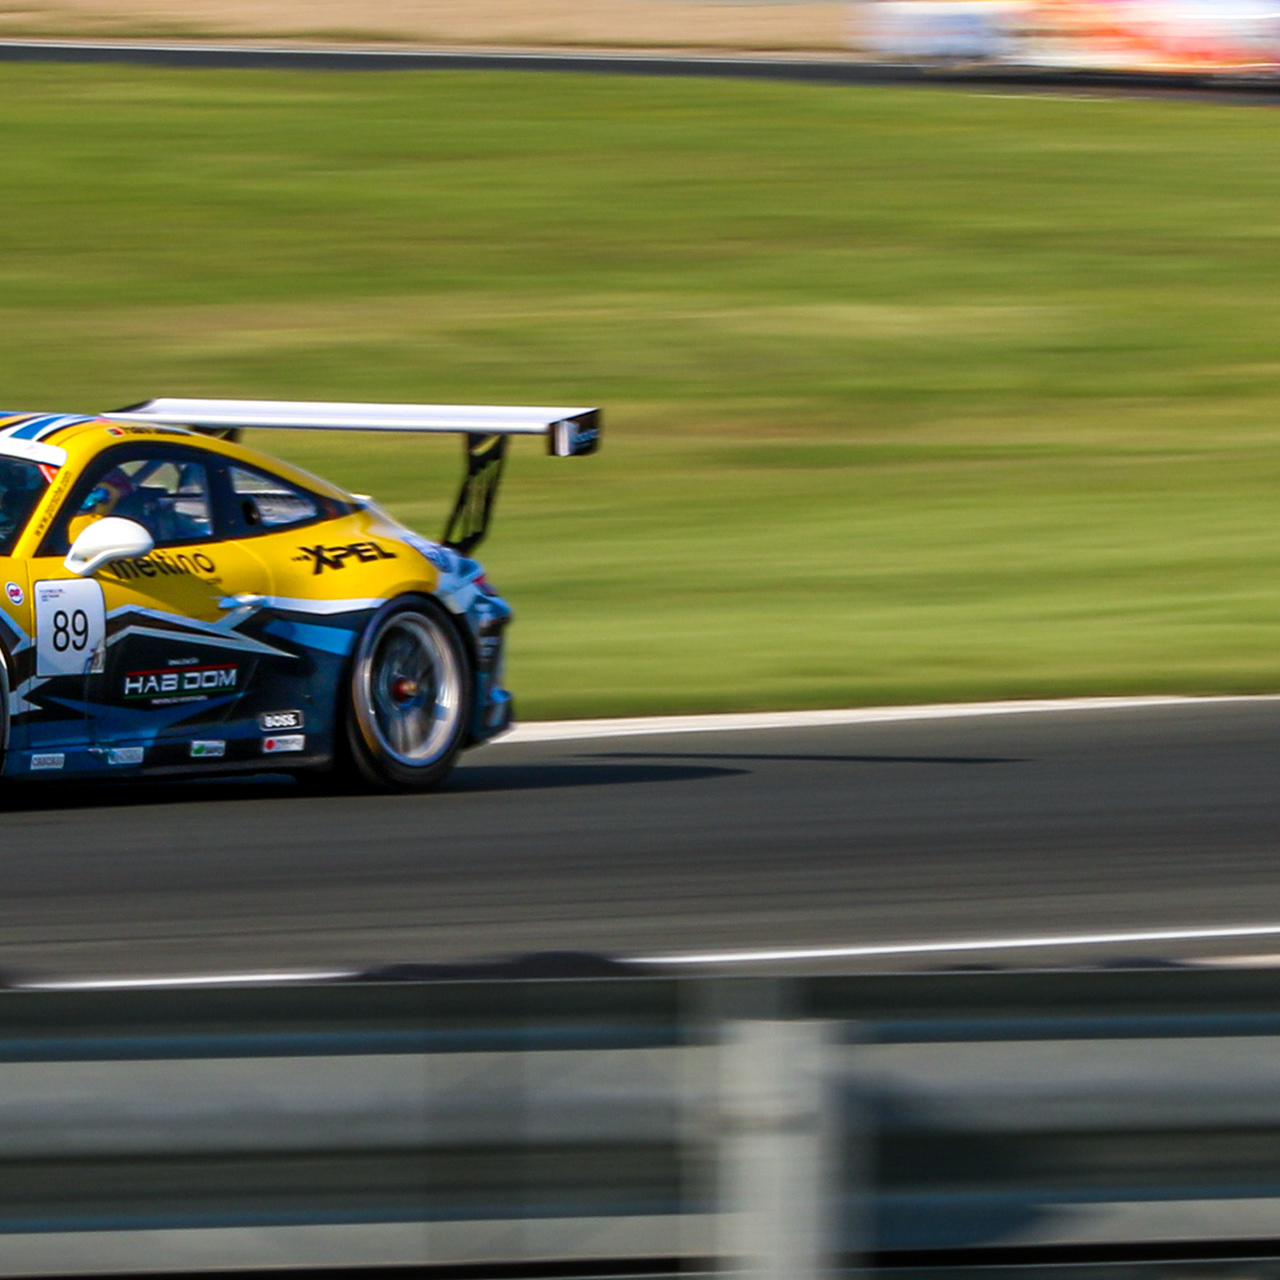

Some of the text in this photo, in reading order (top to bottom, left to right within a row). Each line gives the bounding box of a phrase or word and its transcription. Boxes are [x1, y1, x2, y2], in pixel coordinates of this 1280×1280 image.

[108, 550, 216, 579] meltino
[296, 542, 398, 575] XPEL
[52, 608, 90, 652] 89
[124, 668, 238, 696] HAB DOM
